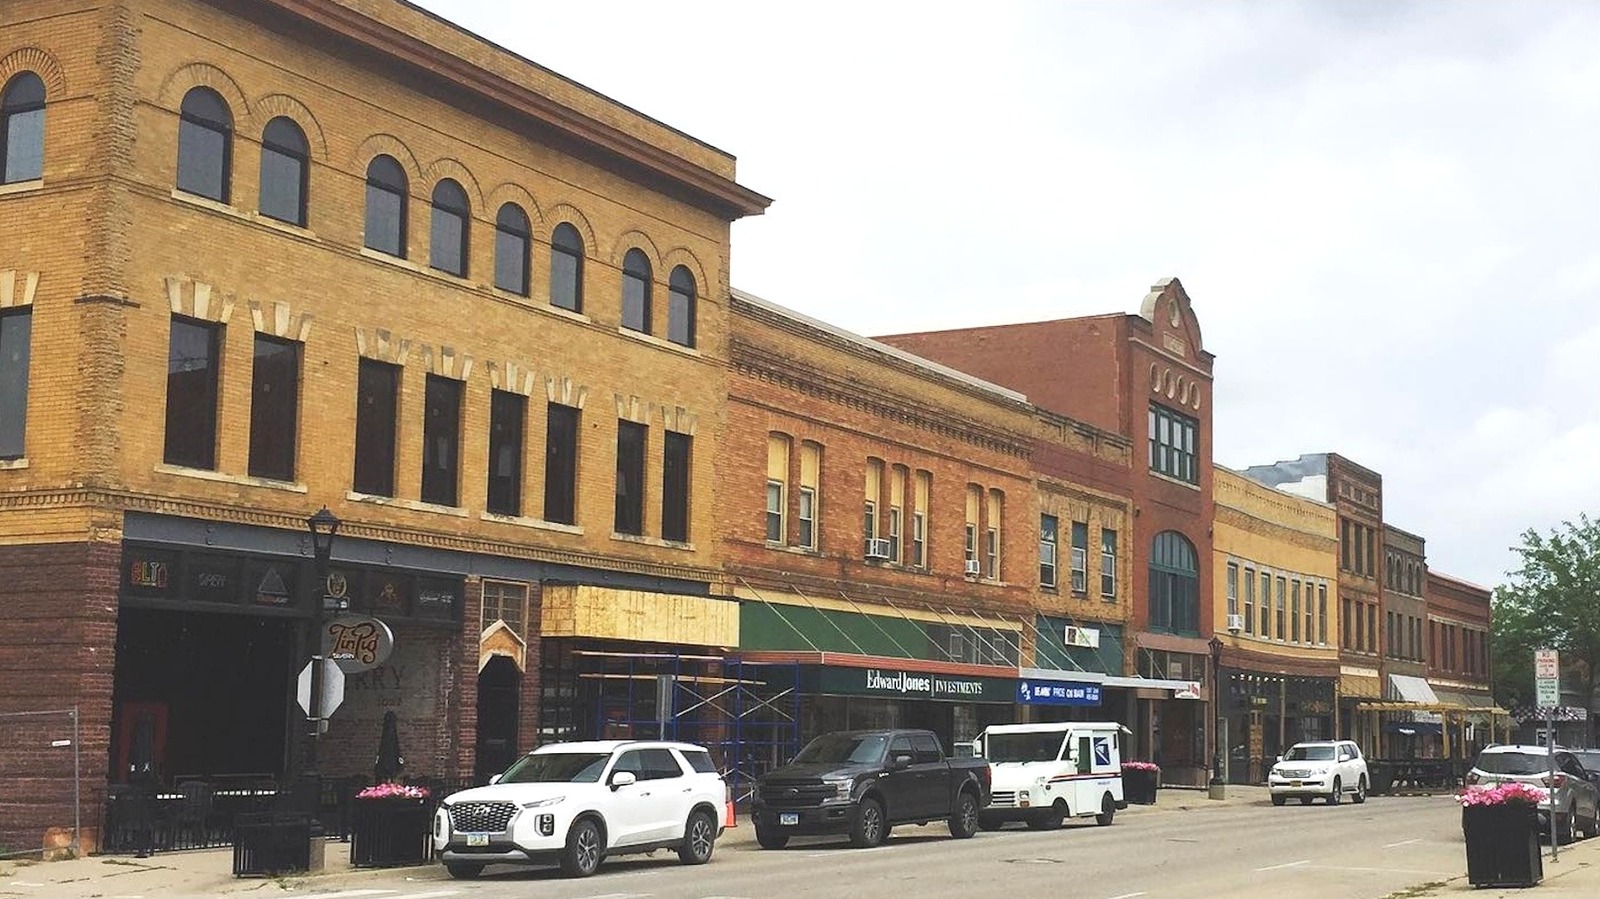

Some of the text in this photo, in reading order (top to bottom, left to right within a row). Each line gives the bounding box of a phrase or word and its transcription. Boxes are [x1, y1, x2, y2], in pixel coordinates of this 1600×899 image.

[329, 622, 380, 663] Tin Pig
[902, 671, 931, 693] Jones
[935, 679, 983, 694] INVESTMENTS
